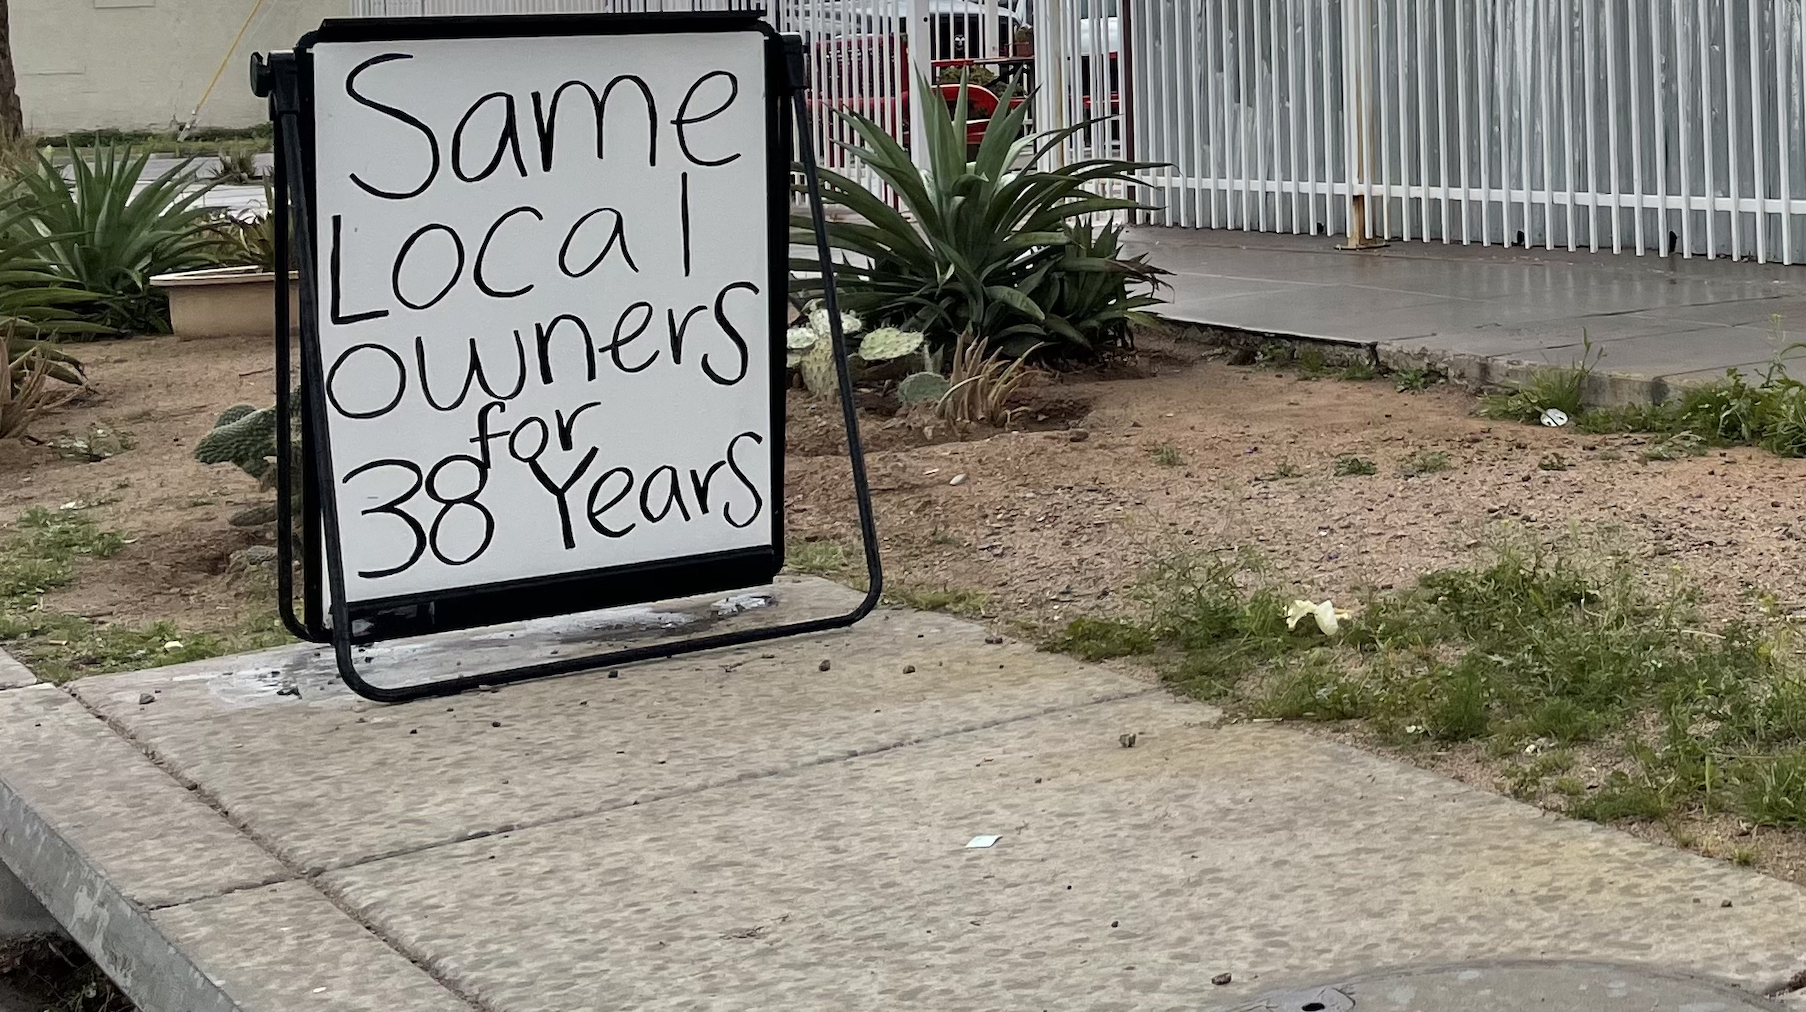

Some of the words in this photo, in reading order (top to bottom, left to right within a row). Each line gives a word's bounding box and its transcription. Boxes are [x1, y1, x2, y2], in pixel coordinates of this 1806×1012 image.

[345, 53, 742, 199] Same
[330, 172, 690, 325] Local
[342, 454, 495, 578] 38
[527, 431, 763, 549] Years
[470, 401, 602, 469] for
